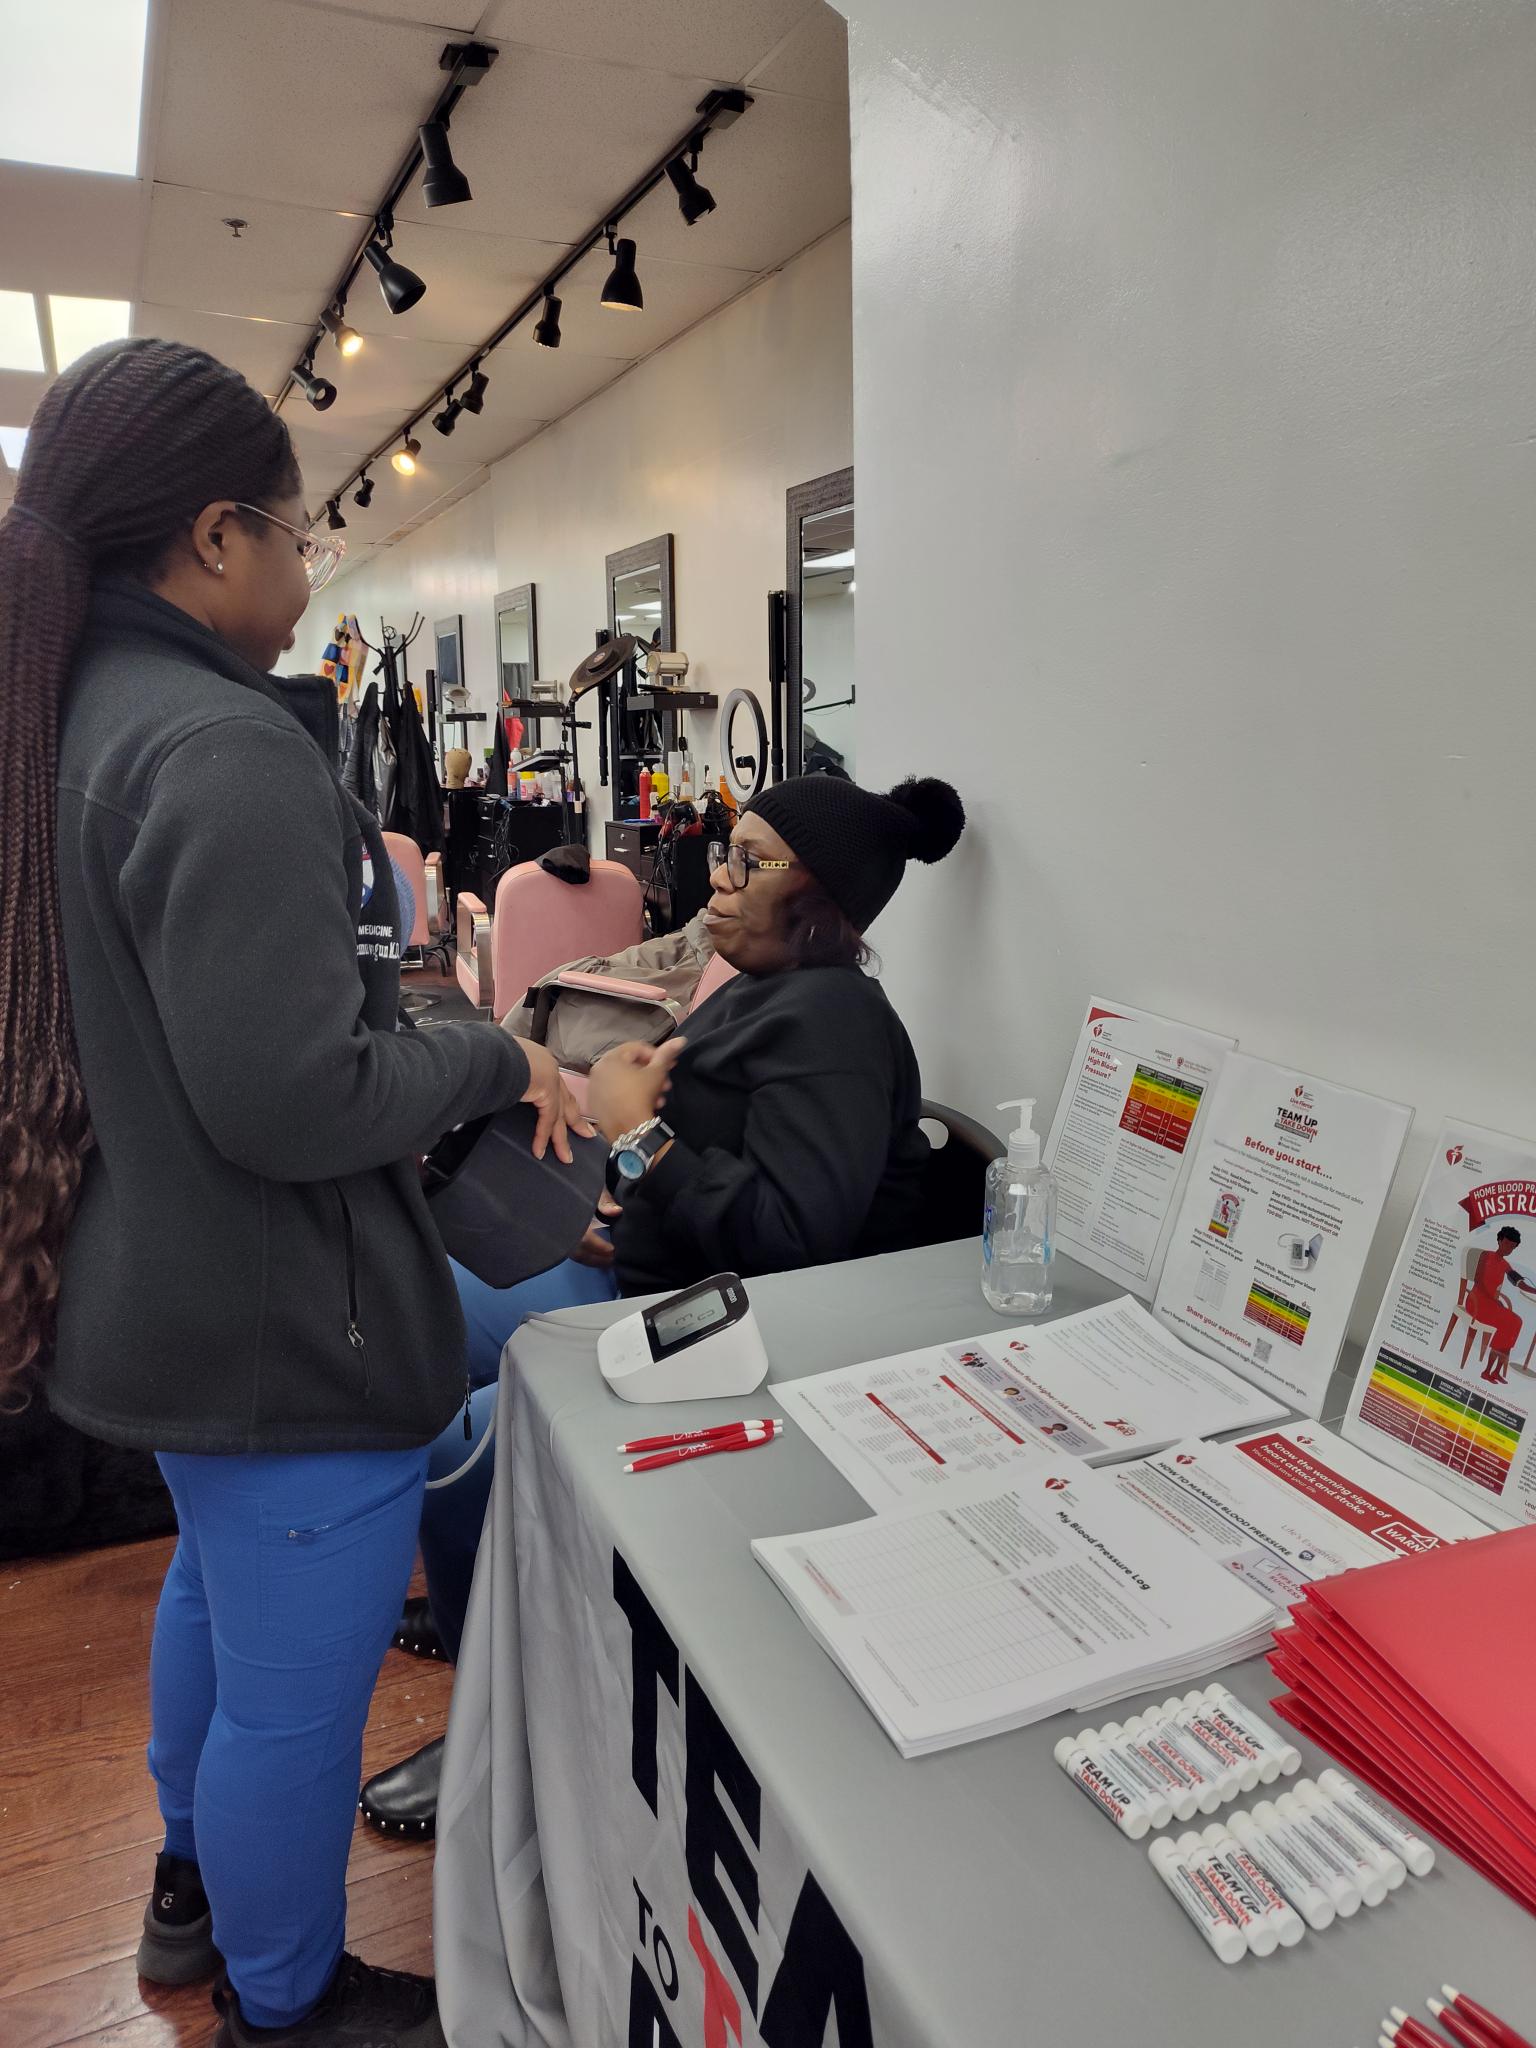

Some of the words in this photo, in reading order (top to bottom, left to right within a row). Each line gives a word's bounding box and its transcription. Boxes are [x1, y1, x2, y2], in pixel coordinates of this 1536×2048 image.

[358, 925, 393, 937] MEDICINE
[1084, 1064, 1111, 1079] Pressure?
[1086, 1055, 1101, 1066] High
[1099, 1060, 1118, 1072] Blood
[1089, 1045, 1106, 1058] What
[1277, 1106, 1303, 1123] TEAM
[1302, 1114, 1318, 1128] UP
[1279, 1117, 1296, 1128] TAKE
[1295, 1122, 1318, 1136] DOWN
[1244, 1136, 1275, 1156] Before
[1274, 1150, 1295, 1164] you
[1474, 1185, 1497, 1200] HOME
[1497, 1182, 1524, 1194] BLOOD
[1525, 1183, 1536, 1194] PR
[1160, 1305, 1172, 1316] Don't
[1171, 1312, 1186, 1324] forget
[1190, 1323, 1200, 1333] take
[1199, 1330, 1226, 1348] information
[1225, 1345, 1240, 1357] about
[1239, 1353, 1250, 1362] high
[1250, 1358, 1264, 1371] blood
[1263, 1368, 1285, 1384] pressure
[1285, 1380, 1296, 1390] with
[1185, 1304, 1204, 1320] Share
[1202, 1315, 1218, 1328] your
[1217, 1324, 1252, 1347] experience
[1001, 1356, 1024, 1376] Women
[1022, 1374, 1038, 1386] face
[1035, 1384, 1057, 1401] higher
[1054, 1399, 1069, 1410] risk
[1074, 1414, 1097, 1430] stroke
[1250, 1447, 1263, 1457] You
[1261, 1455, 1281, 1468] could
[1277, 1467, 1293, 1478] save
[1289, 1476, 1307, 1487] your
[1259, 1444, 1287, 1463] heart
[1284, 1461, 1316, 1483] attack
[1313, 1481, 1338, 1496] and
[1333, 1494, 1365, 1515] stroke
[1270, 1441, 1298, 1460] Know
[1296, 1458, 1313, 1470] the
[1312, 1469, 1352, 1496] warning
[1349, 1493, 1377, 1511] signs
[1375, 1509, 1392, 1518] of
[1157, 1461, 1178, 1476] HOW
[1176, 1475, 1189, 1484] TO
[1187, 1482, 1223, 1507] MANAGE
[1220, 1505, 1250, 1527] BLOOD
[1247, 1526, 1291, 1556] PRESSURE
[1055, 1511, 1071, 1523] My
[1069, 1522, 1098, 1544] Blood
[1093, 1542, 1132, 1574] Pressure
[1130, 1573, 1151, 1590] Log
[1269, 1574, 1301, 1599] SUCCESS
[1191, 1723, 1212, 1745] TAKE
[1212, 1708, 1245, 1739] TEAM
[1245, 1732, 1265, 1751] UP
[1212, 1717, 1233, 1740] TAKE
[1232, 1734, 1257, 1761] DOWN
[1080, 1756, 1112, 1789] TEAM
[1111, 1787, 1131, 1806] UP
[1157, 1736, 1179, 1759] TAKE
[1178, 1755, 1205, 1784] DOWN
[1080, 1769, 1101, 1792] TAKE
[1099, 1789, 1125, 1818] DOWN
[1205, 1866, 1228, 1893] TAKE
[1225, 1892, 1251, 1925] DOWN
[1208, 1855, 1242, 1893] TEAM
[1240, 1895, 1261, 1915] UP
[1237, 1855, 1259, 1878] TAKE
[1257, 1878, 1284, 1910] DOWN
[632, 1875, 679, 2002] TO
